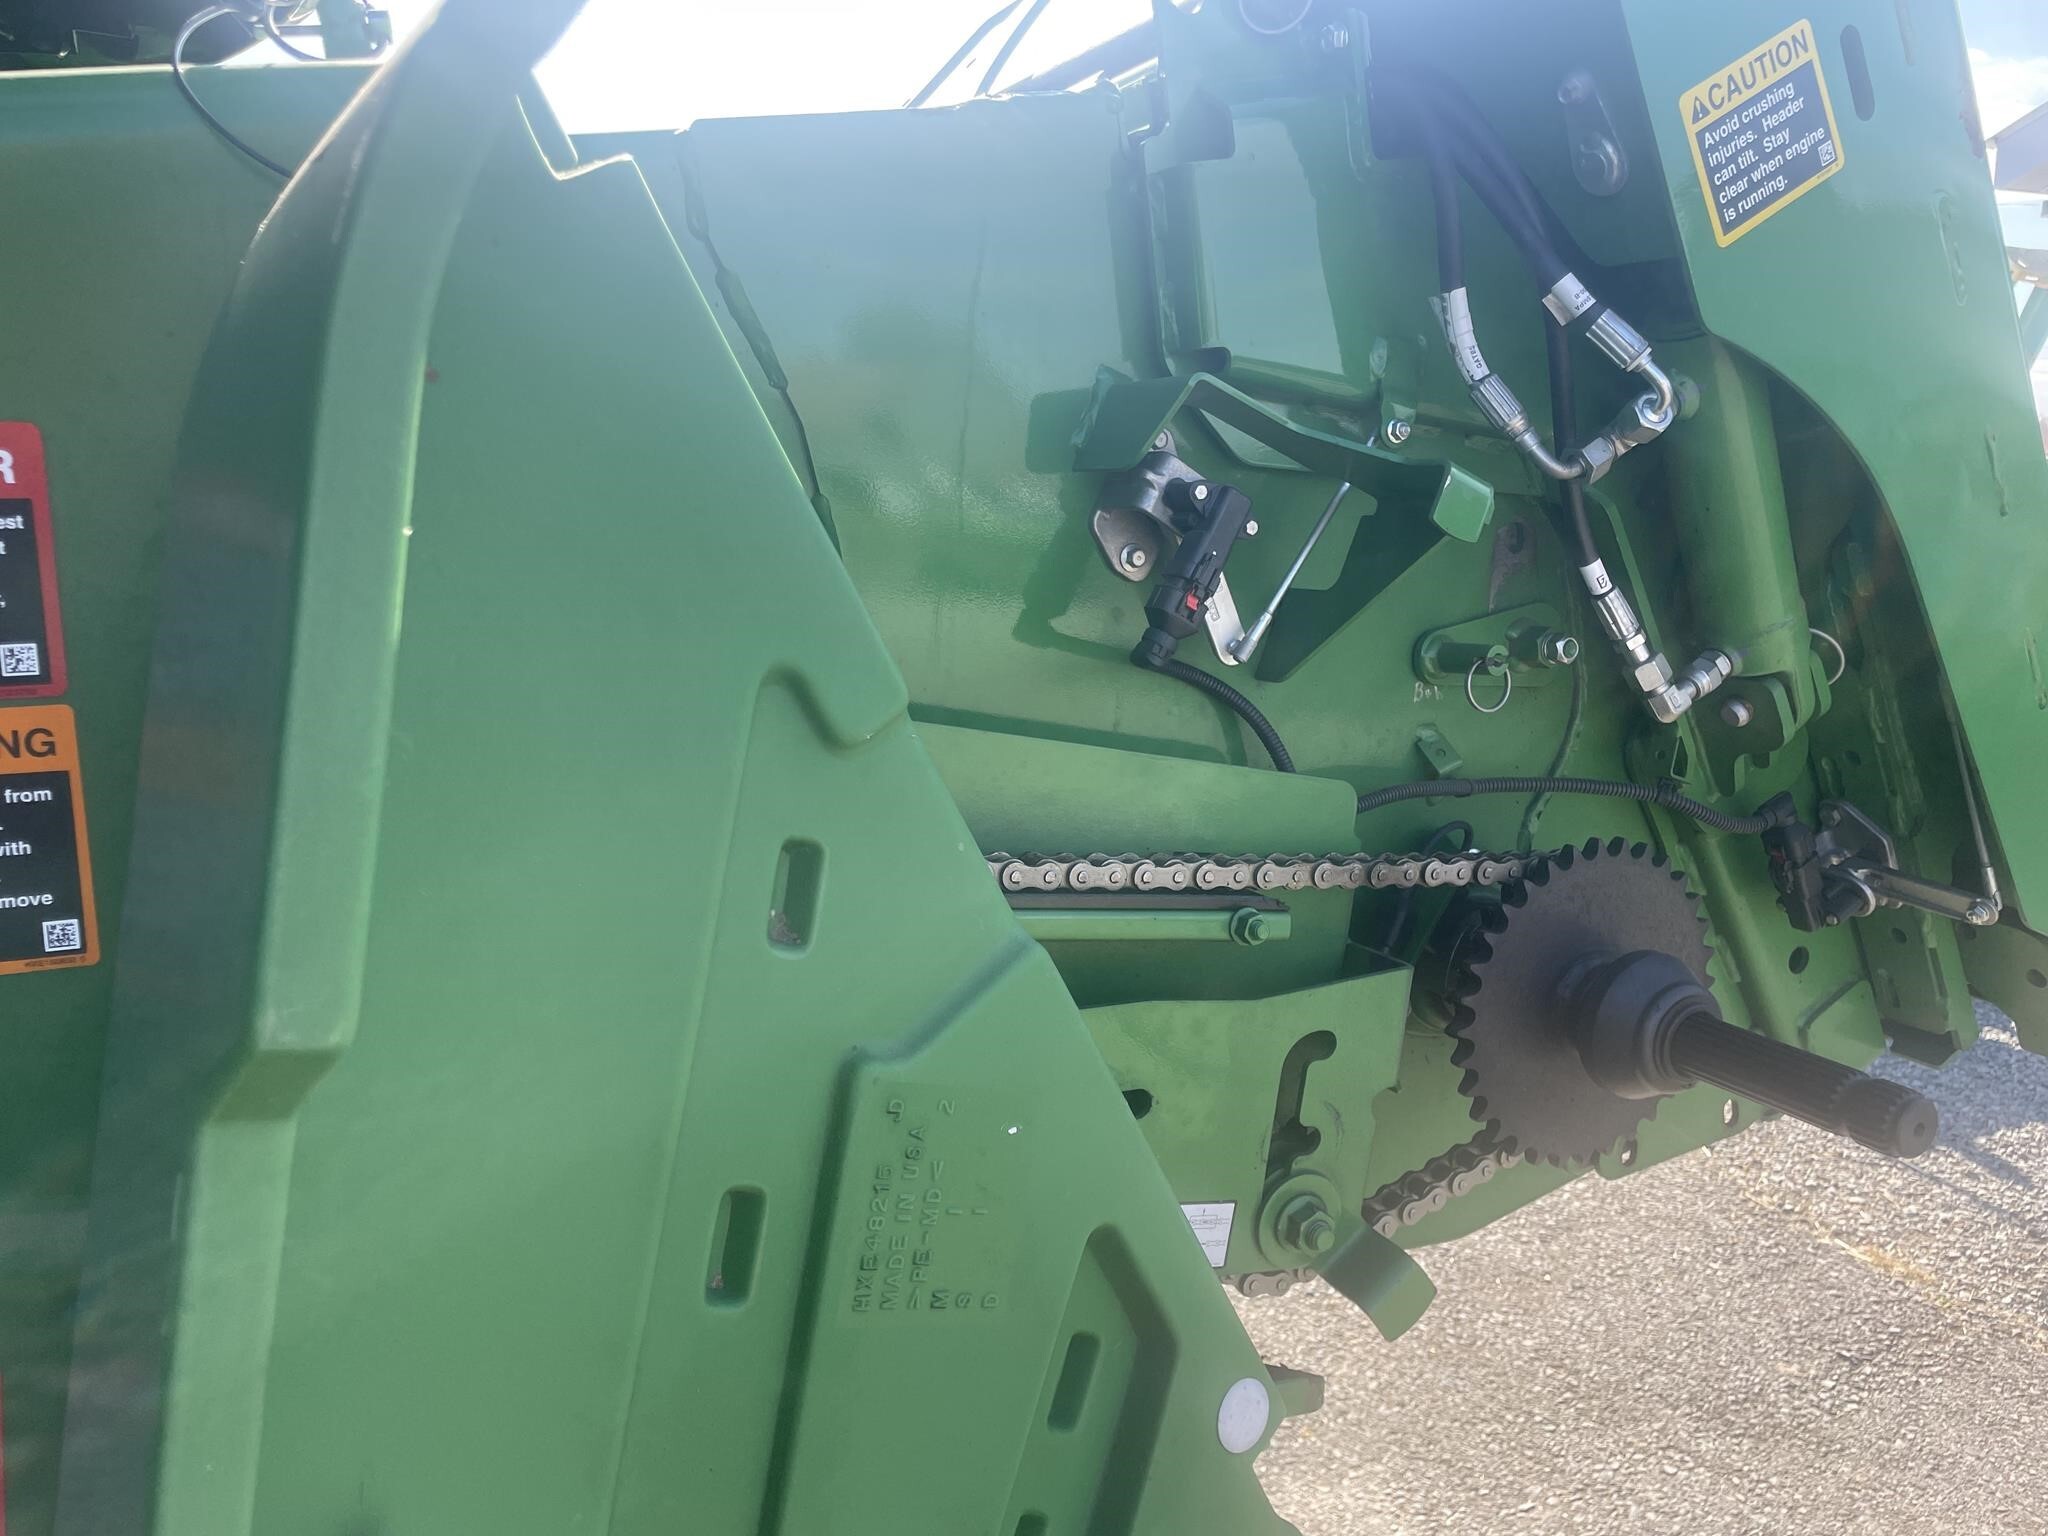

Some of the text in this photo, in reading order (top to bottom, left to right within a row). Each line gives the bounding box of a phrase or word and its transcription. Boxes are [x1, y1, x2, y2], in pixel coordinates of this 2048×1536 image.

[1708, 28, 1809, 111] CAUTION
[1704, 81, 1795, 148] Avoid crushing
[1708, 96, 1805, 167] injuries. Header
[1714, 127, 1790, 186] can tilt. Stay
[1719, 176, 1749, 204] clear
[1751, 156, 1784, 182] when
[1786, 127, 1825, 160] engine
[1723, 174, 1788, 223] is running.
[4, 788, 53, 804] from
[880, 1125, 926, 1311] MADE IN USA
